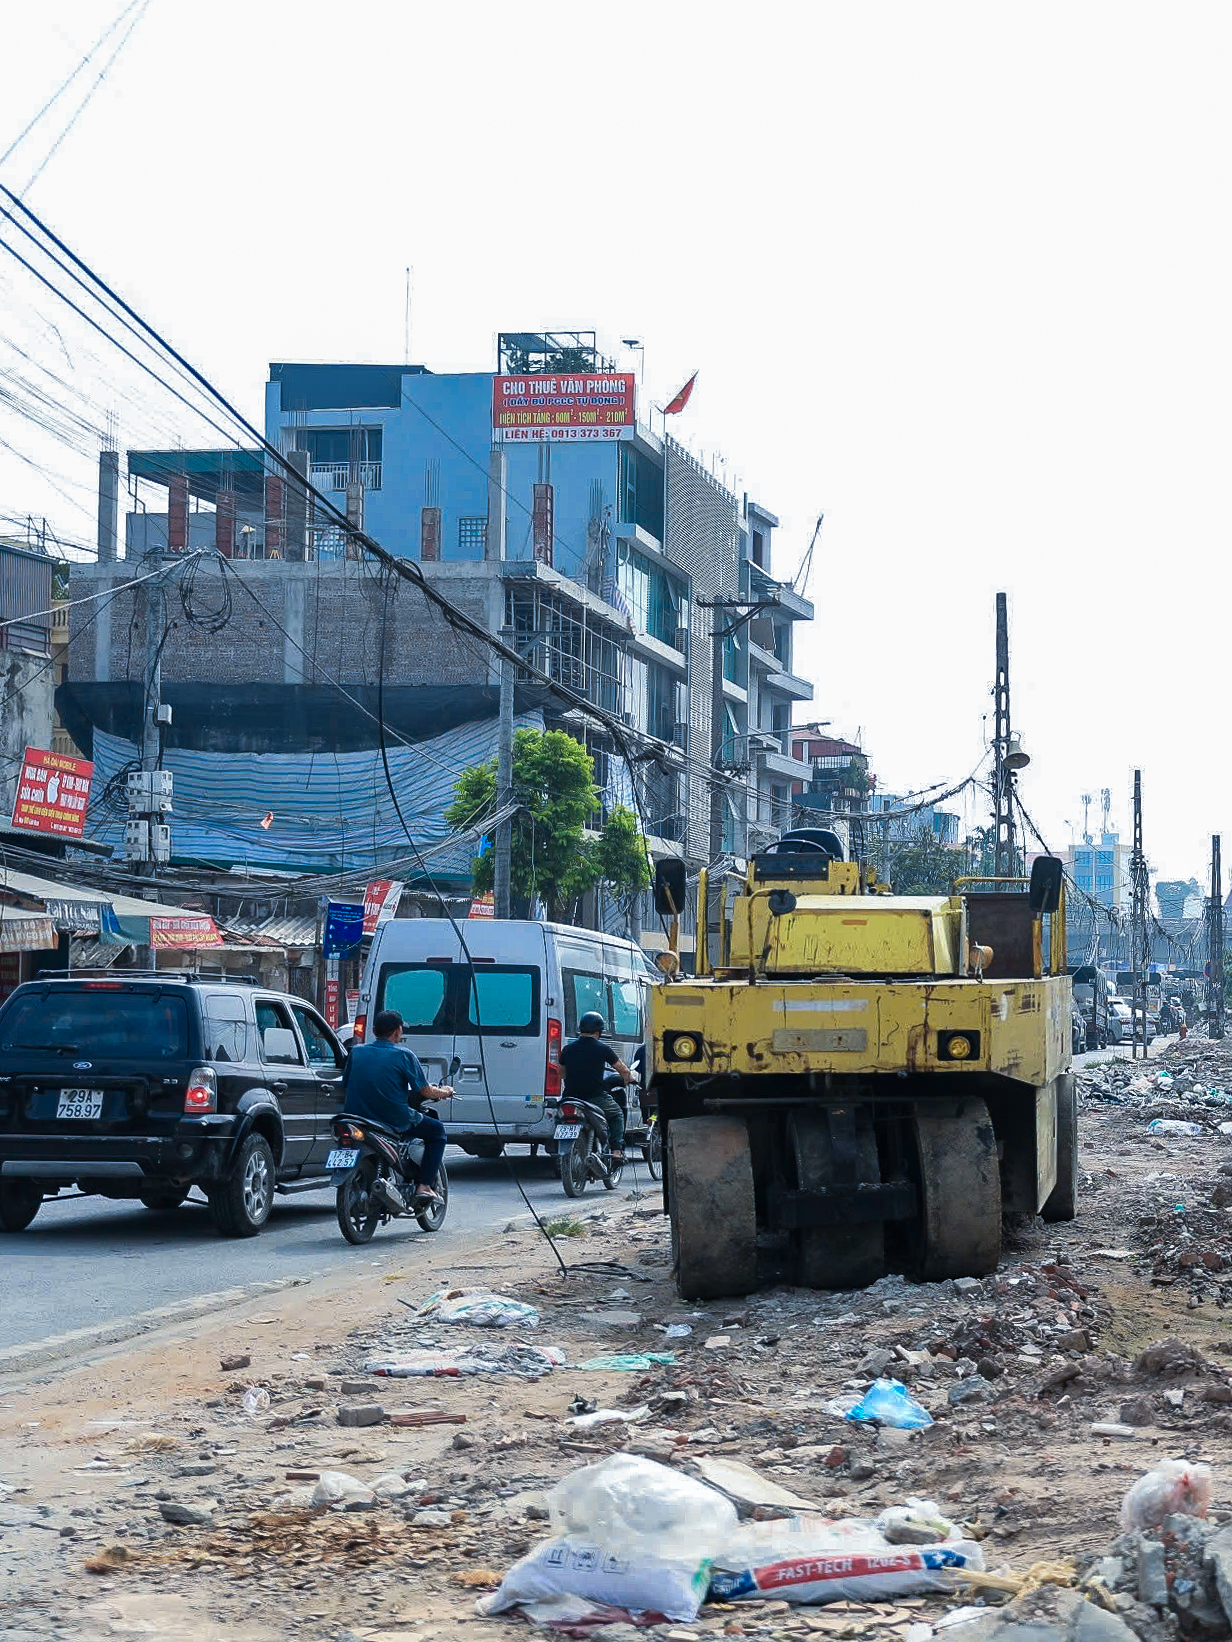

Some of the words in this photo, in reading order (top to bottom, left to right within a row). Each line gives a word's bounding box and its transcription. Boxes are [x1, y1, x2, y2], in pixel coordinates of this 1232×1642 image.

[503, 381, 526, 395] CHO
[528, 377, 557, 395] THUÊ
[560, 377, 584, 394] VĂN
[586, 376, 626, 393] PHÒNG
[505, 429, 528, 440] LIÊN
[551, 429, 577, 439] 0913
[580, 429, 599, 438] 373
[602, 429, 622, 438] 367
[68, 1090, 92, 1103] 29A
[57, 1104, 101, 1118] 758.97
